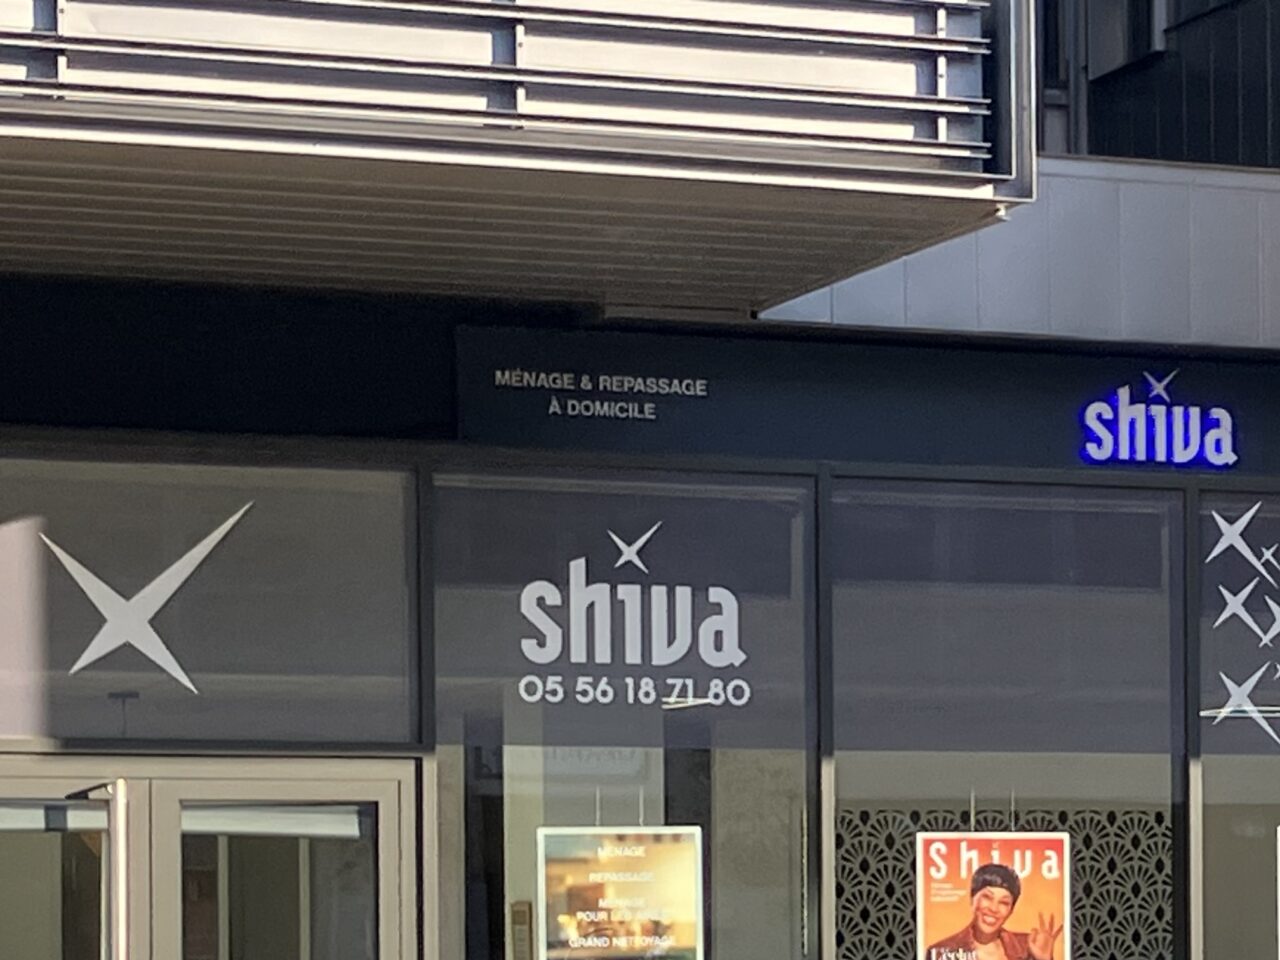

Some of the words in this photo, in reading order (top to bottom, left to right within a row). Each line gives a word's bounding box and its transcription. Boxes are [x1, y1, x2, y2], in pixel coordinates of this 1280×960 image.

[495, 369, 574, 389] MÉNAGE
[580, 375, 592, 390] &
[599, 375, 707, 395] REPASSAGE
[549, 395, 561, 415] À
[567, 400, 656, 419] DOMICILE
[1084, 368, 1238, 466] shiva
[520, 521, 748, 668] shiva
[518, 674, 565, 703] 05
[575, 676, 614, 703] 56
[624, 677, 657, 704] 18
[665, 678, 694, 703] 71
[707, 678, 751, 706] 80
[576, 911, 608, 921] POUR
[568, 936, 610, 948] GRAND
